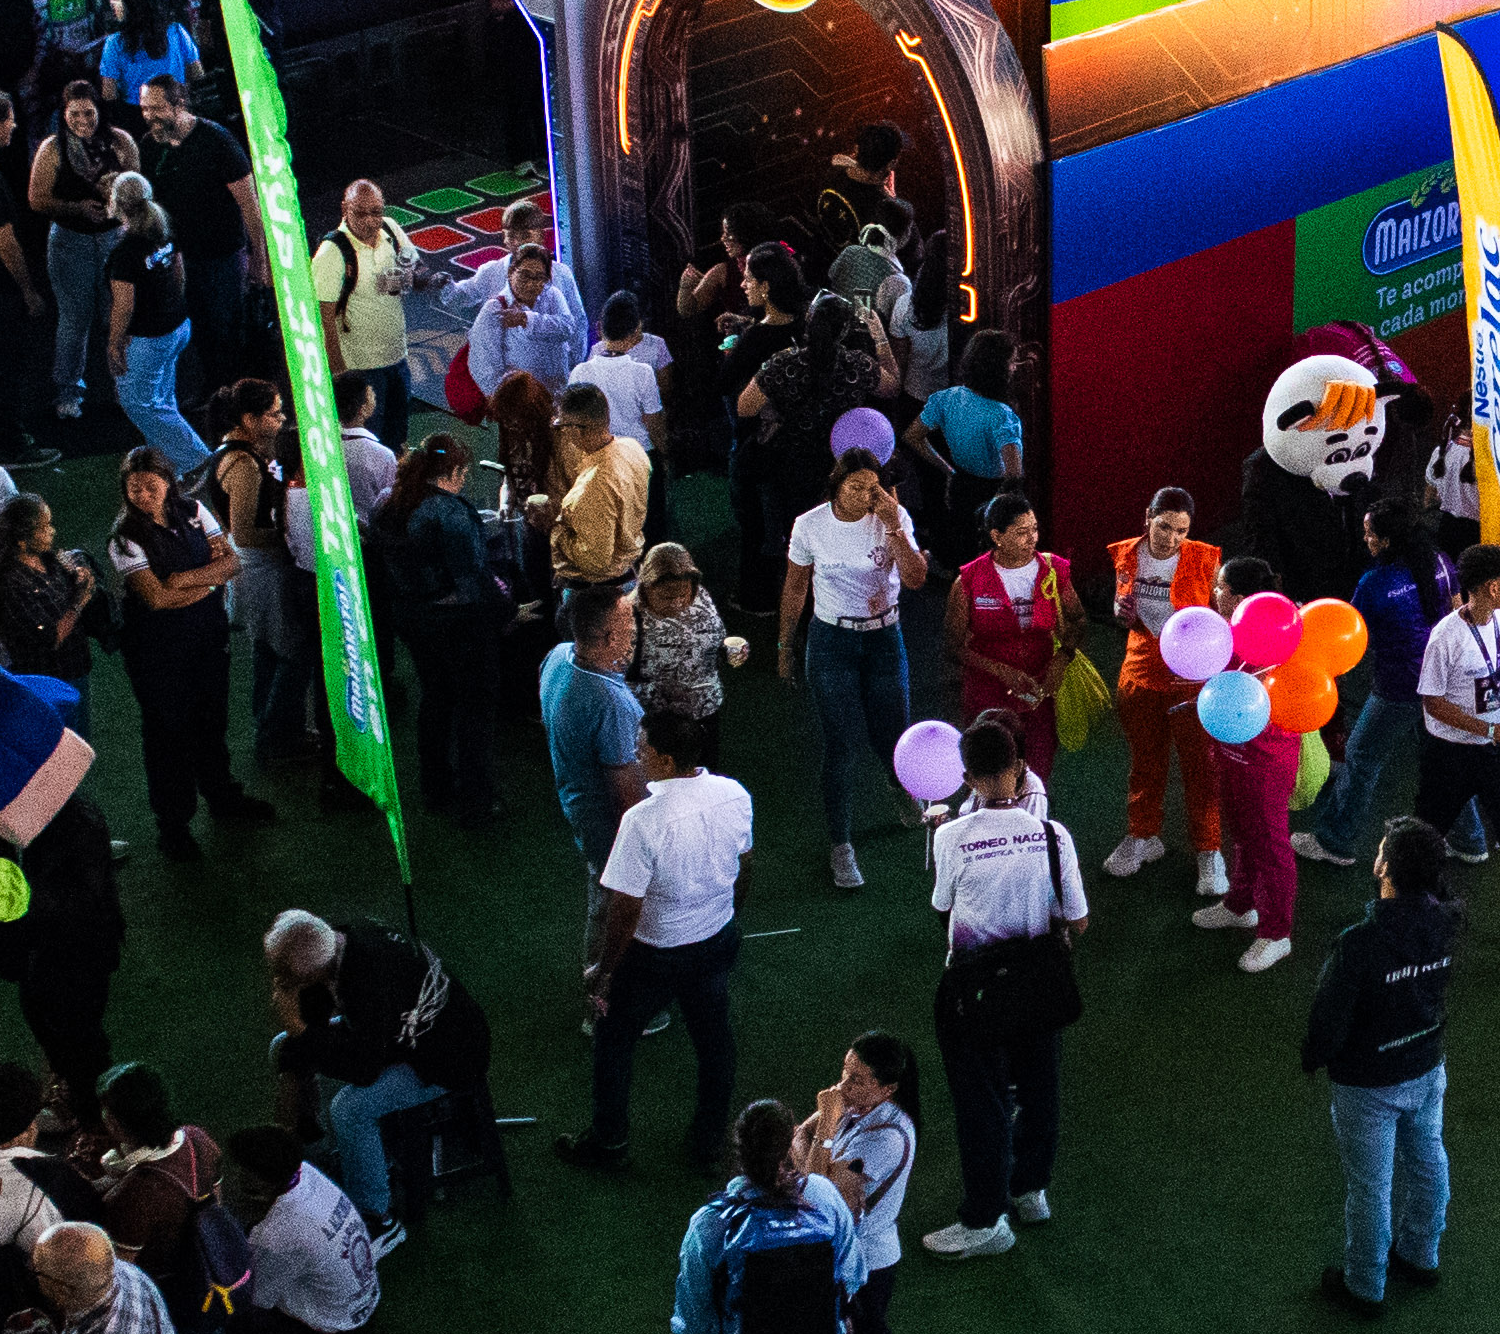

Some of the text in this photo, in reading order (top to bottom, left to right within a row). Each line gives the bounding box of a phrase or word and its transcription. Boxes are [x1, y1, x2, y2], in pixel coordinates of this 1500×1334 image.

[1375, 201, 1461, 266] MAIZOR
[1376, 263, 1463, 309] Te acomp
[1380, 302, 1425, 338] cada
